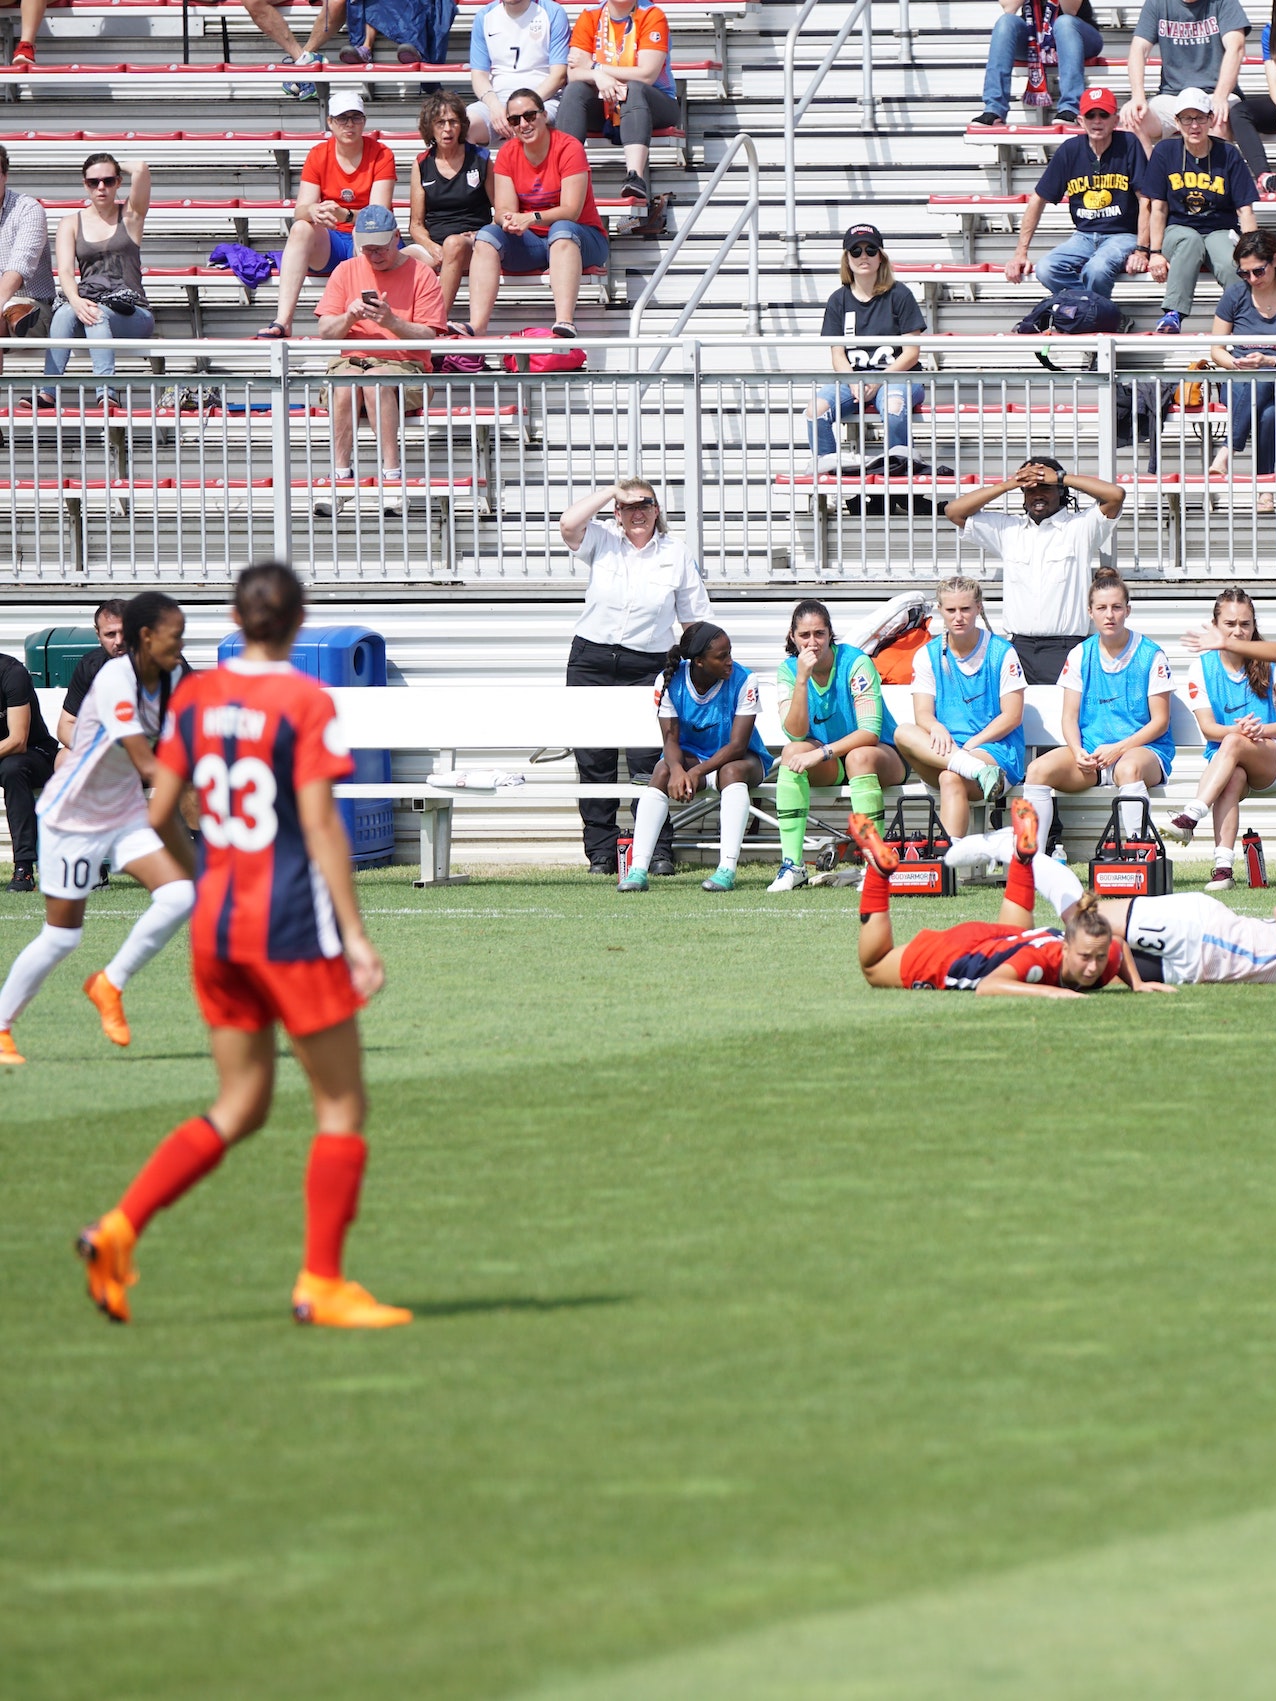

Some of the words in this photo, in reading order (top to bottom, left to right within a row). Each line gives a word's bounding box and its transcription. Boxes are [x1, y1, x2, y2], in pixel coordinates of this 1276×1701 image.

[510, 47, 520, 69] 7
[1168, 172, 1225, 195] BOCA
[192, 753, 279, 854] 33
[61, 857, 91, 889] 10
[1138, 926, 1166, 951] 13
